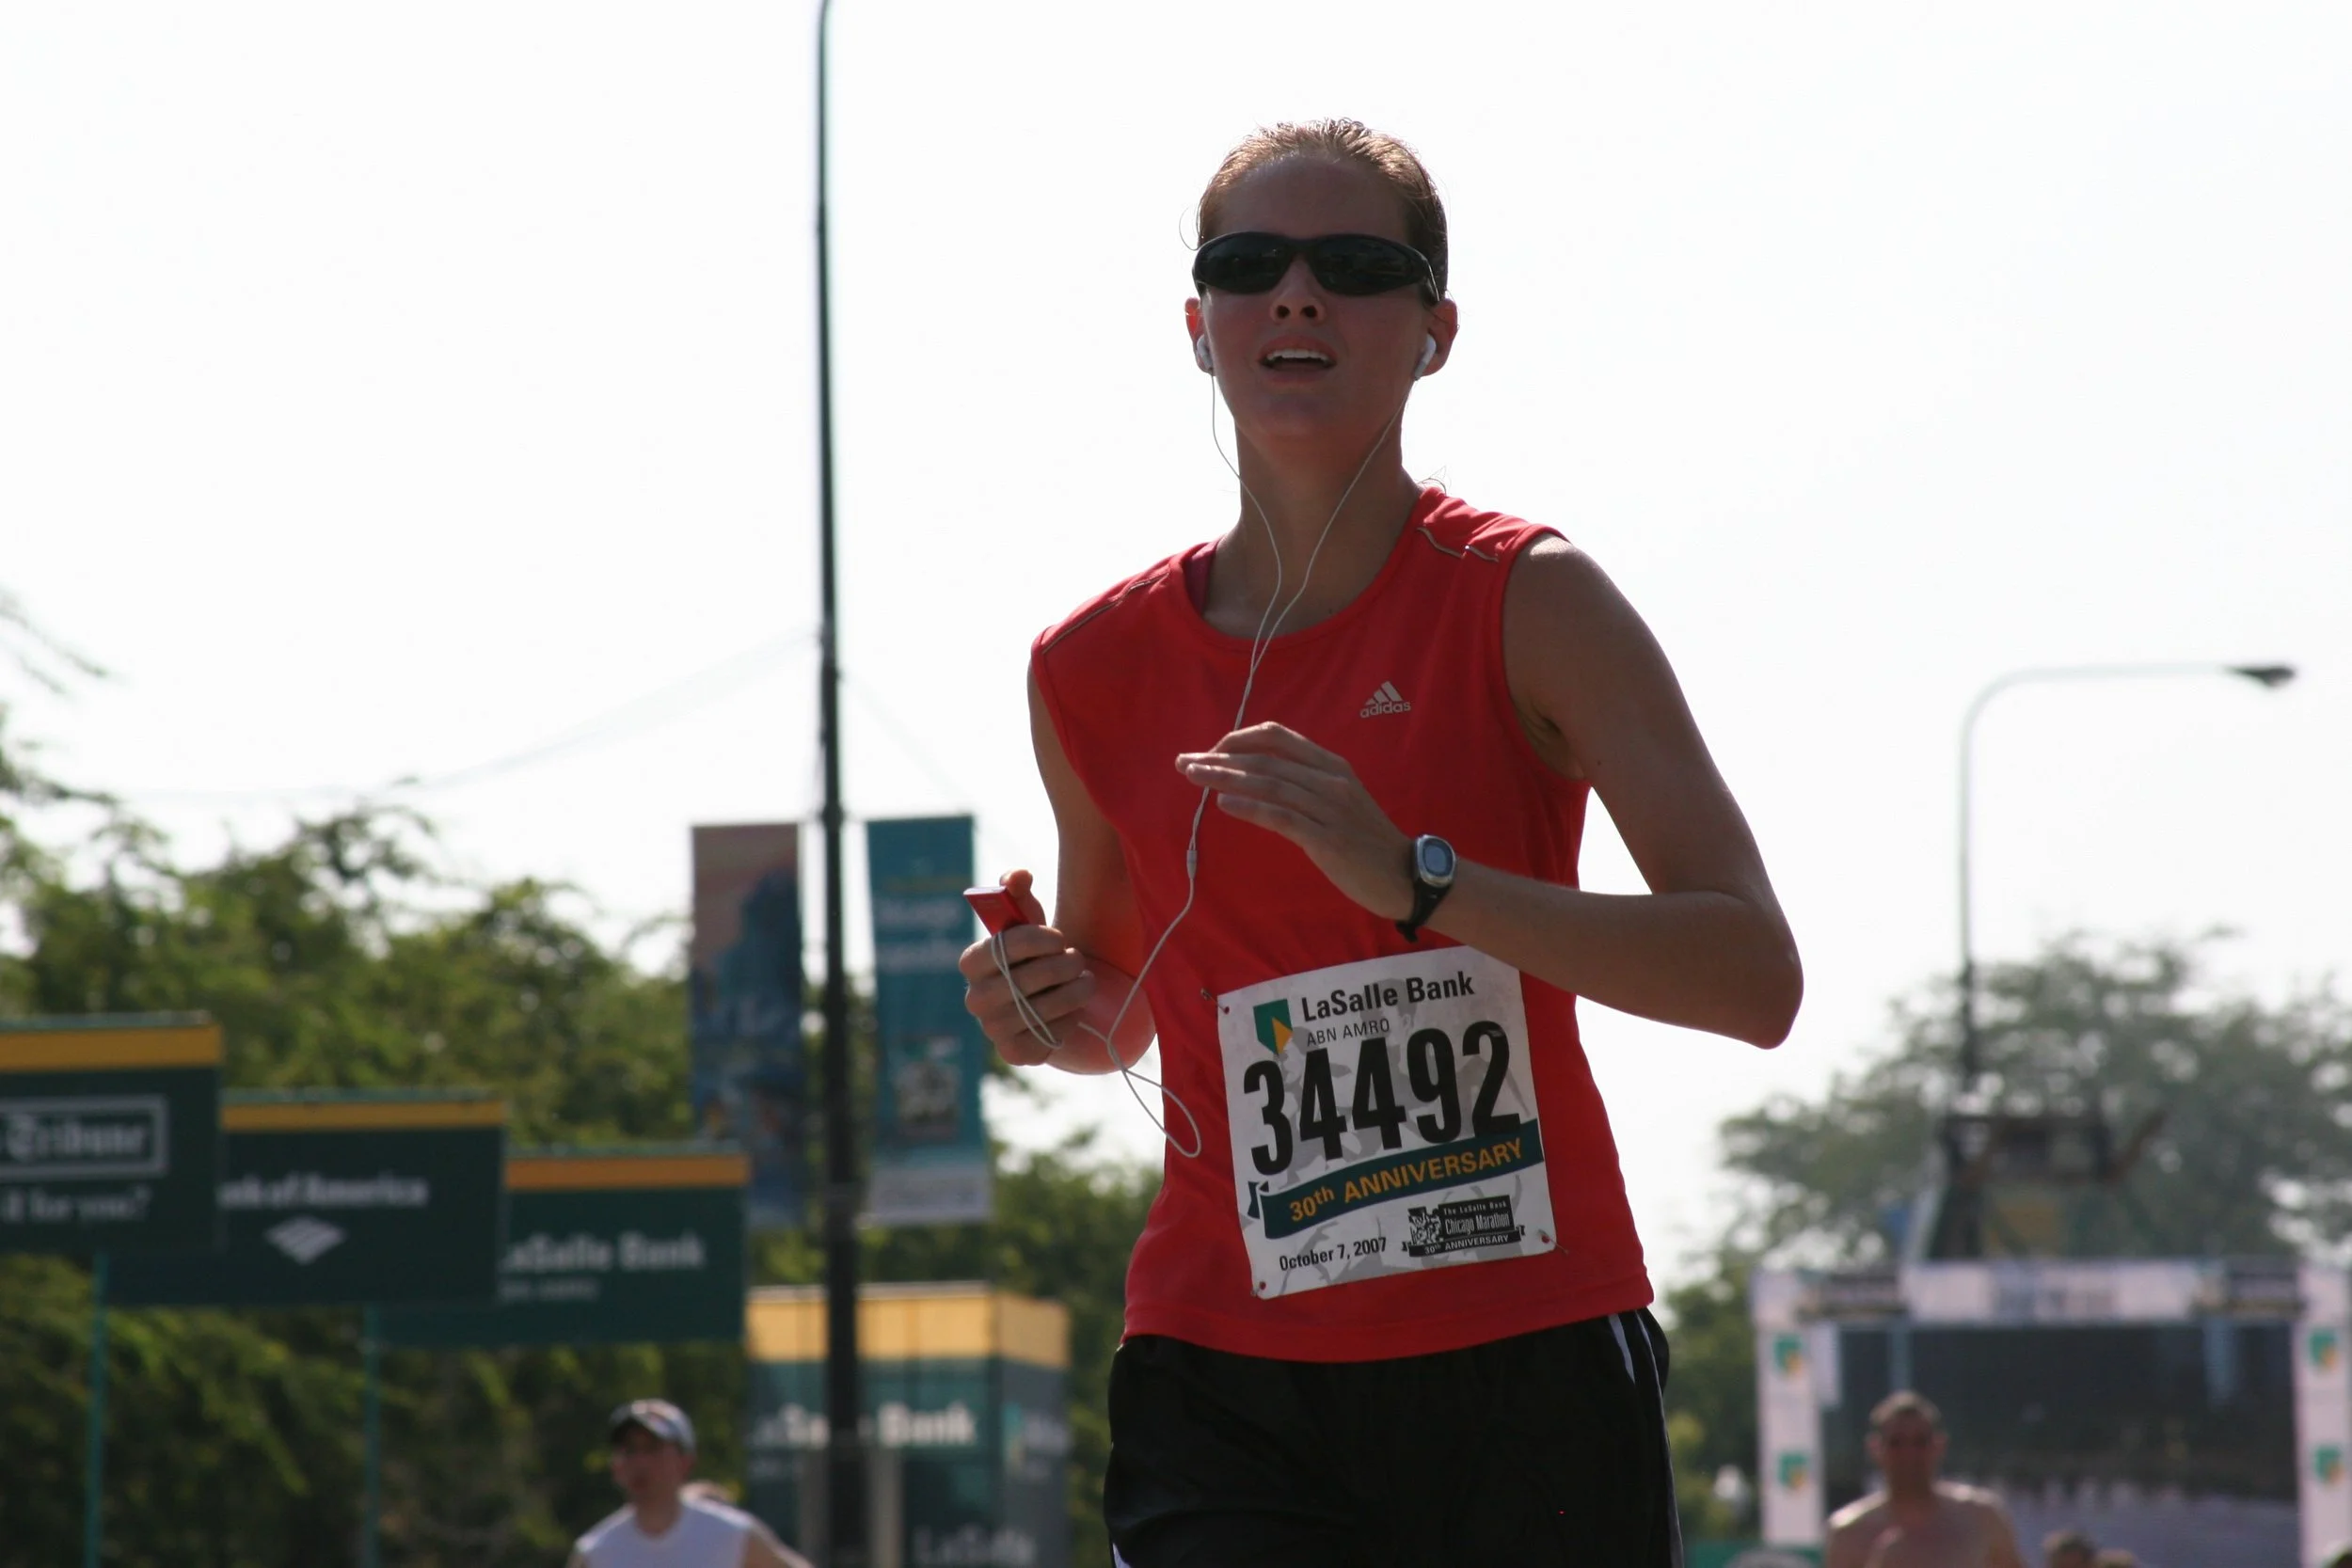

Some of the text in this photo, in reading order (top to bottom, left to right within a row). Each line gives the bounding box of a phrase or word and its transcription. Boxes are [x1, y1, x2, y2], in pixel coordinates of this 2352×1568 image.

[1359, 700, 1411, 718] adidas
[1301, 971, 1475, 1022] LaSalle Bank
[1306, 1017, 1391, 1048] ABN AMRO
[1243, 1021, 1522, 1176] 34492
[305, 1170, 430, 1208] America
[1289, 1138, 1521, 1223] 30th ANNIVERSARY
[1443, 1207, 1457, 1216] The
[1459, 1203, 1487, 1214] LaSalle
[1444, 1211, 1510, 1235] Chicago Marathon
[618, 1227, 707, 1272] Bank
[1279, 1236, 1388, 1272] October 7, 2007
[1444, 1234, 1509, 1250] ANNIVERSARY
[877, 1400, 978, 1449] Bank
